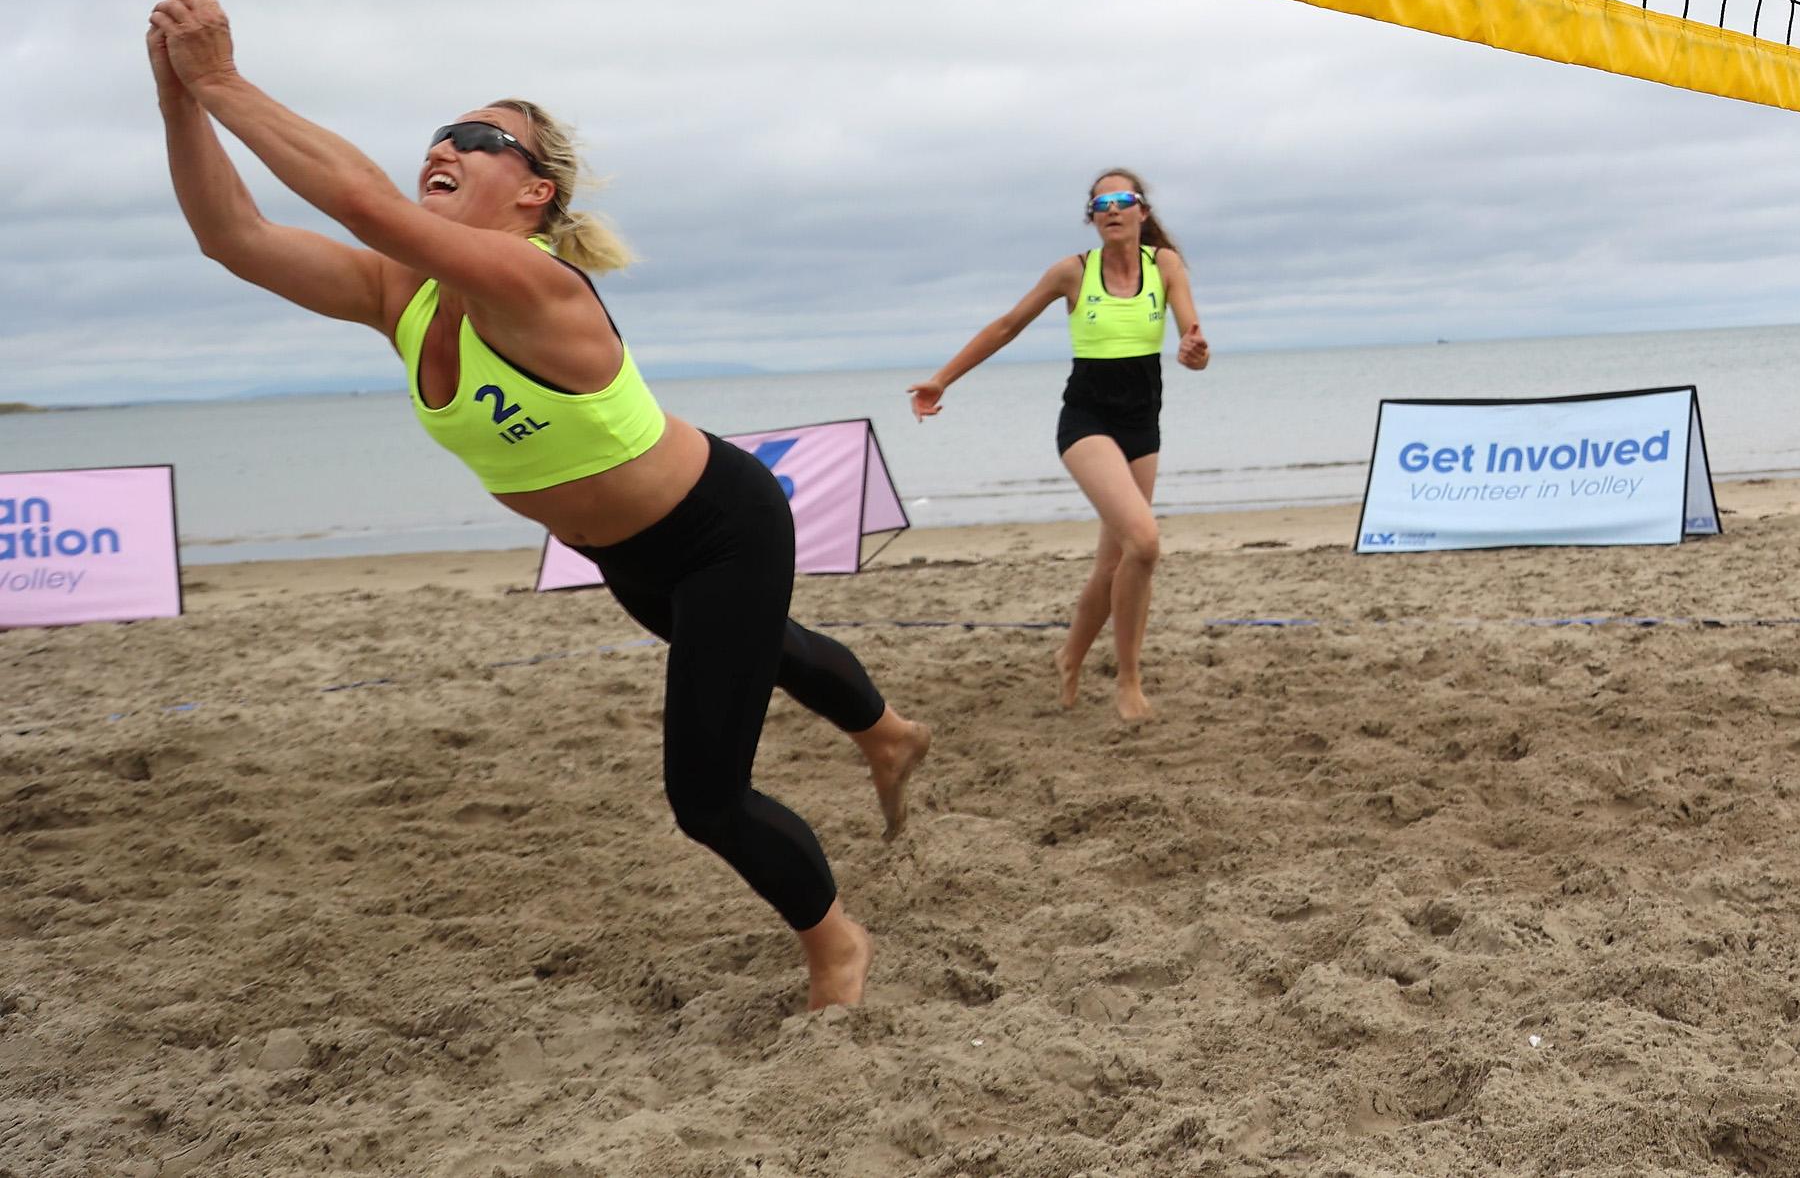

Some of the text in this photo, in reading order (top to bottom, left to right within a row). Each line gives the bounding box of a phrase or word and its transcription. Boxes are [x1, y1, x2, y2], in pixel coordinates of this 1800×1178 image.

[1148, 292, 1157, 309] 1
[474, 384, 522, 424] 2
[498, 416, 551, 445] IRL
[1399, 430, 1670, 473] Get Involved
[1409, 475, 1644, 502] Volunteer in Volley
